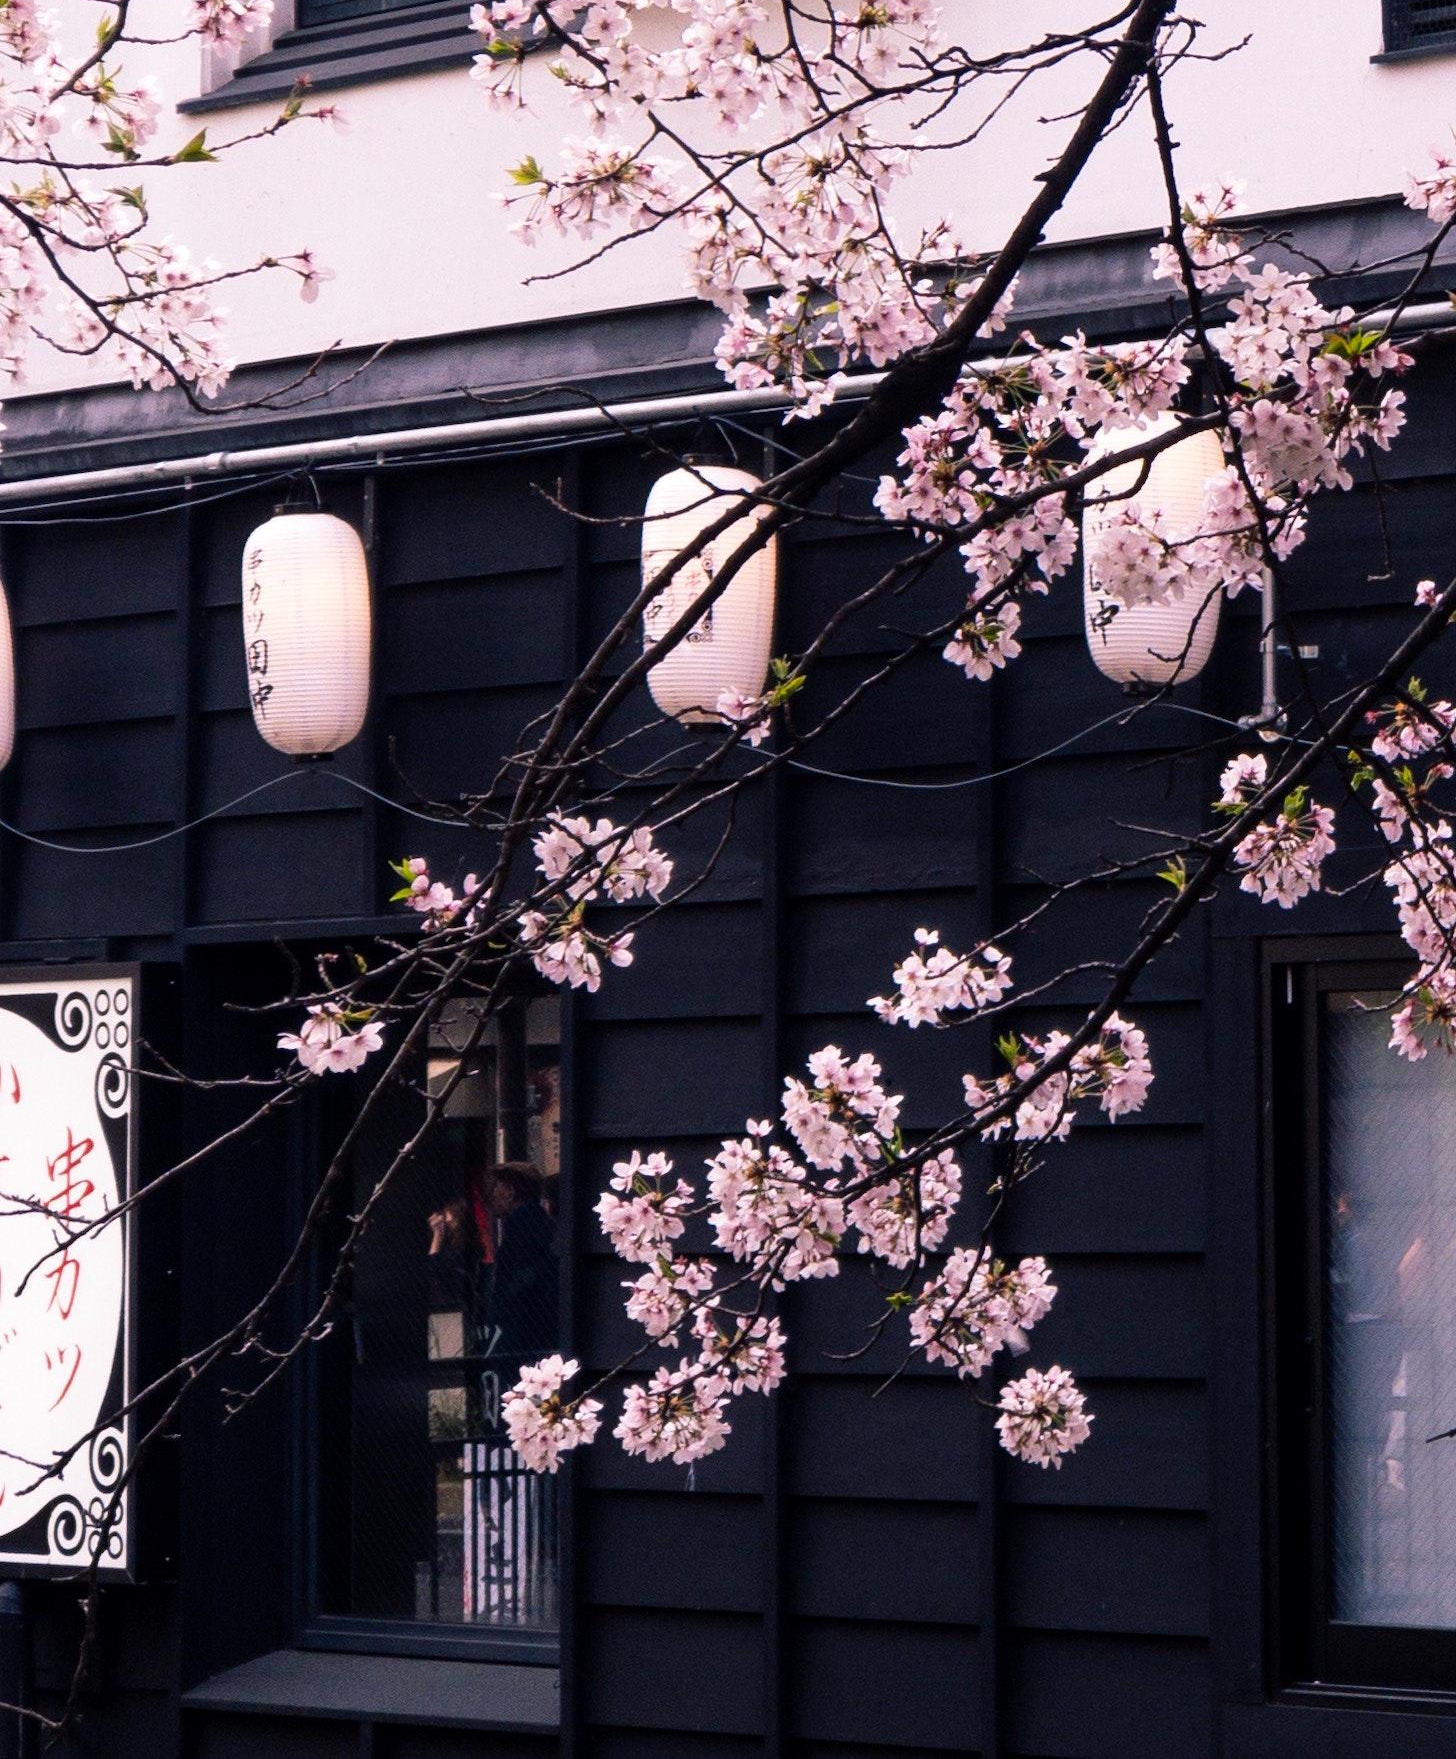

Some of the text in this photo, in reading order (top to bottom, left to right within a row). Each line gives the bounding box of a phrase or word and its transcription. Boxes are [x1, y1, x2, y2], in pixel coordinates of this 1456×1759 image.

[246, 547, 275, 721] 串カツ田中
[43, 1124, 95, 1413] 串カツ
